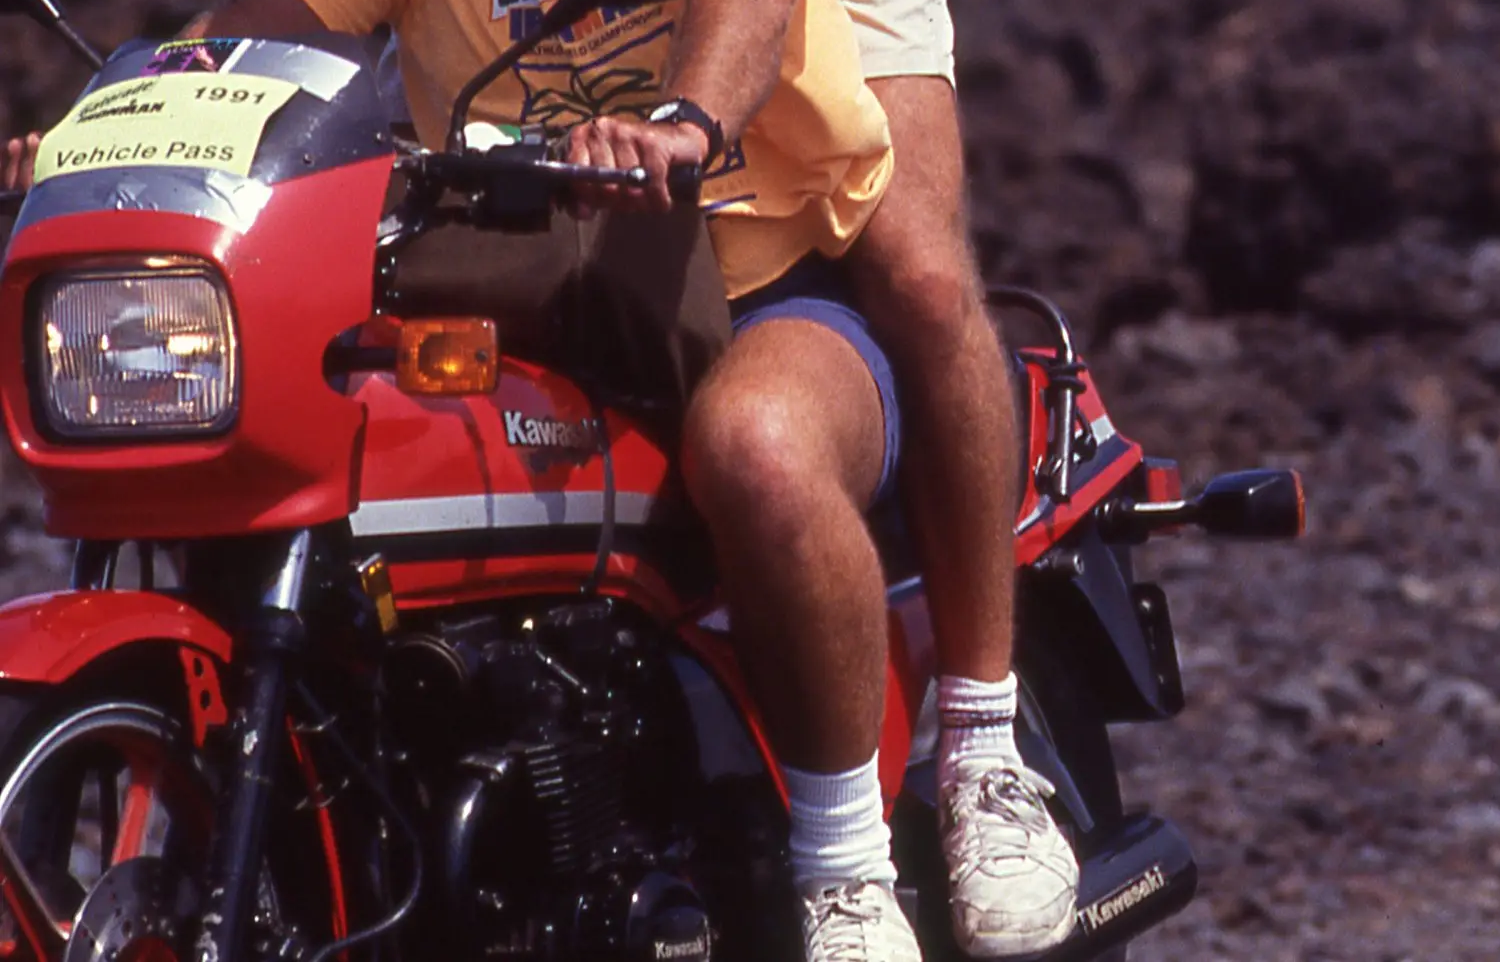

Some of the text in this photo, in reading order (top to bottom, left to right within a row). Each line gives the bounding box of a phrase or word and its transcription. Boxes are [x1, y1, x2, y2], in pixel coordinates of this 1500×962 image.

[194, 86, 267, 105] 1991
[56, 141, 235, 169] Vehicle Pass
[1085, 865, 1165, 931] Kawasaki
